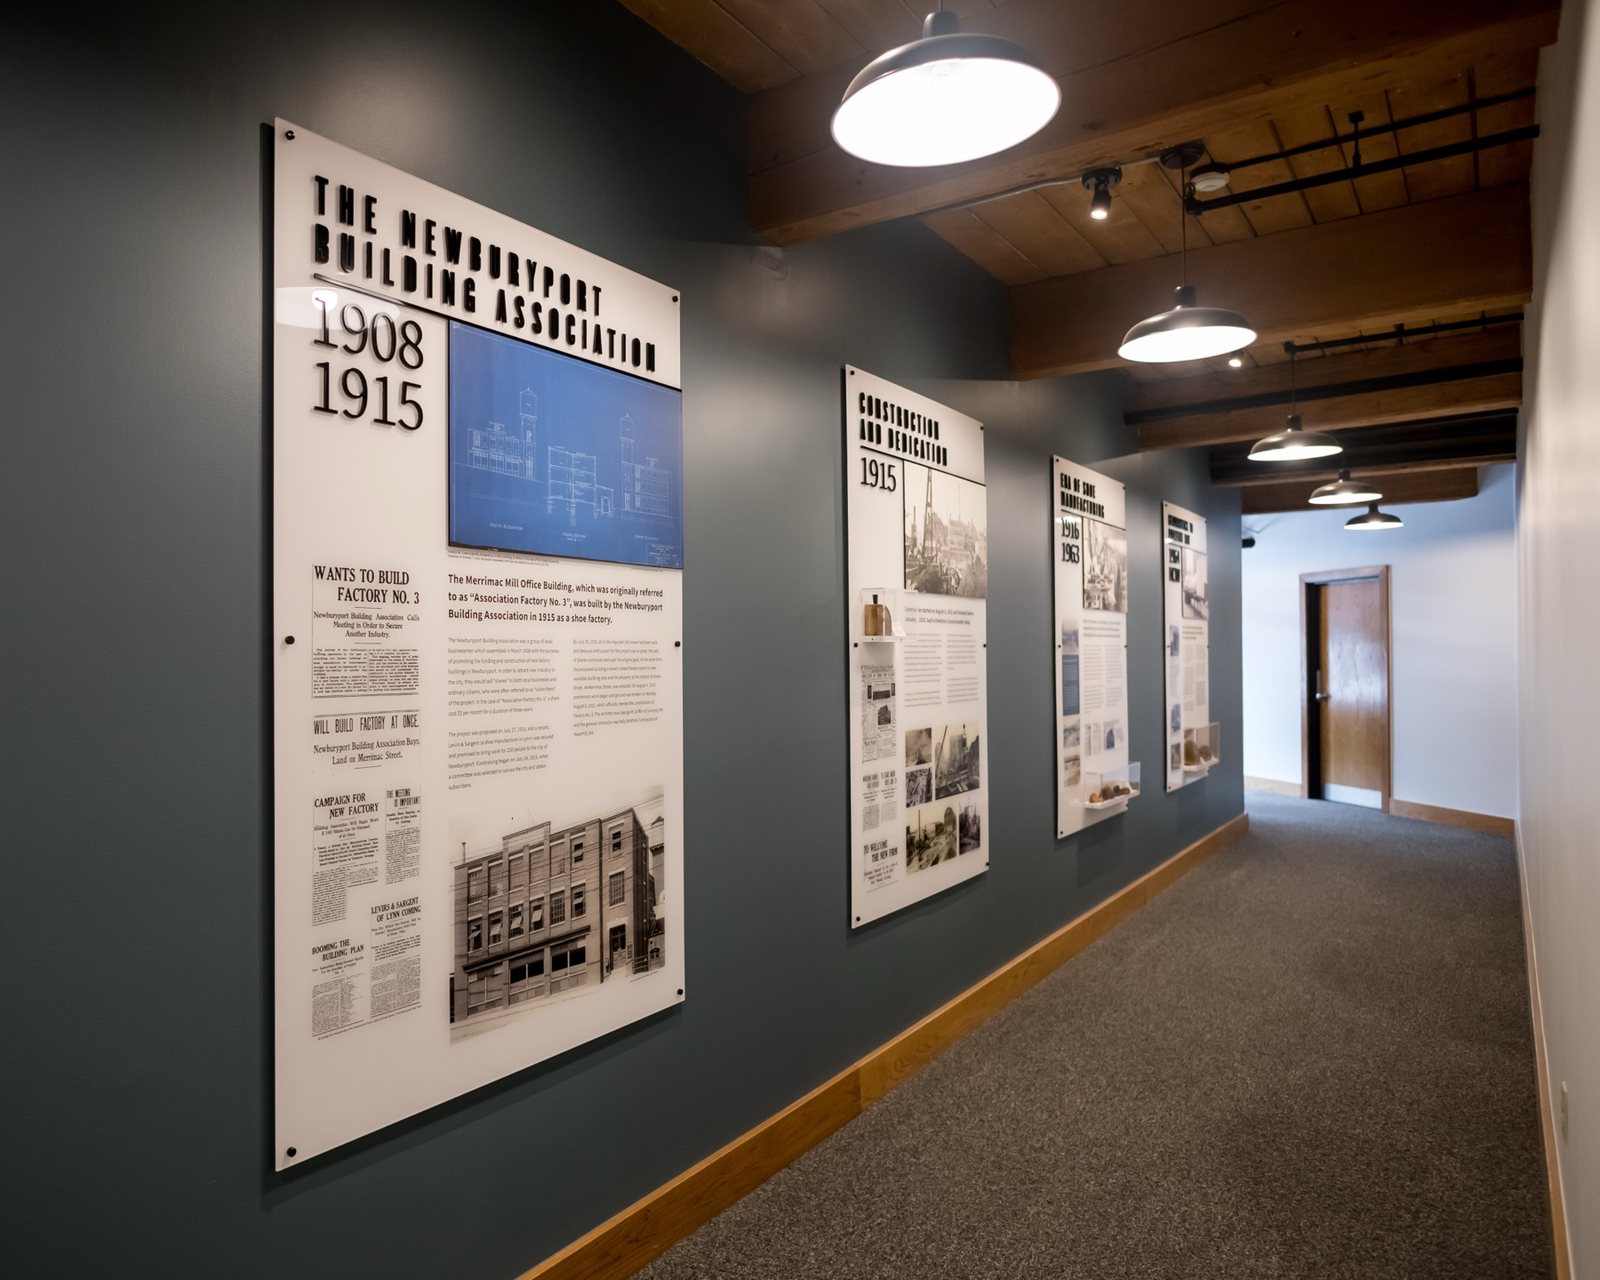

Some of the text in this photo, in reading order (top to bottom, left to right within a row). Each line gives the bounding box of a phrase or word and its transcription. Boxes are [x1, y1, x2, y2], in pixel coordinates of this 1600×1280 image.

[313, 174, 602, 317] THE NEWBURYPORT
[313, 223, 656, 372] BUILDING ASSOCIATION
[313, 297, 424, 371] 1908
[313, 361, 424, 431] 1915
[859, 392, 939, 440] CONSTRUCTION
[860, 418, 947, 467] AND DEDICATION
[860, 457, 896, 492] 1915
[314, 566, 410, 585] WANTS TO BUILD
[448, 574, 663, 598] The Merrimac Mill Office Building, which was originally referred
[338, 587, 420, 604] FACTORY NO. 3
[448, 592, 457, 601] to
[458, 594, 469, 602] as
[520, 596, 548, 608] Factory
[549, 598, 561, 606] No.
[573, 600, 587, 608] was
[588, 599, 603, 609] built
[604, 600, 612, 611] by
[613, 600, 624, 610] the
[624, 601, 664, 612] Newburyport
[448, 609, 613, 625] Building Association in 1915 as a shoe factory.
[314, 720, 330, 735] WILL
[335, 718, 354, 733] BUILD
[360, 716, 386, 731] FACTORY
[391, 715, 398, 729] AT
[314, 793, 366, 808] CAMPAIGN FOR
[329, 802, 379, 819] NEW FACTORY
